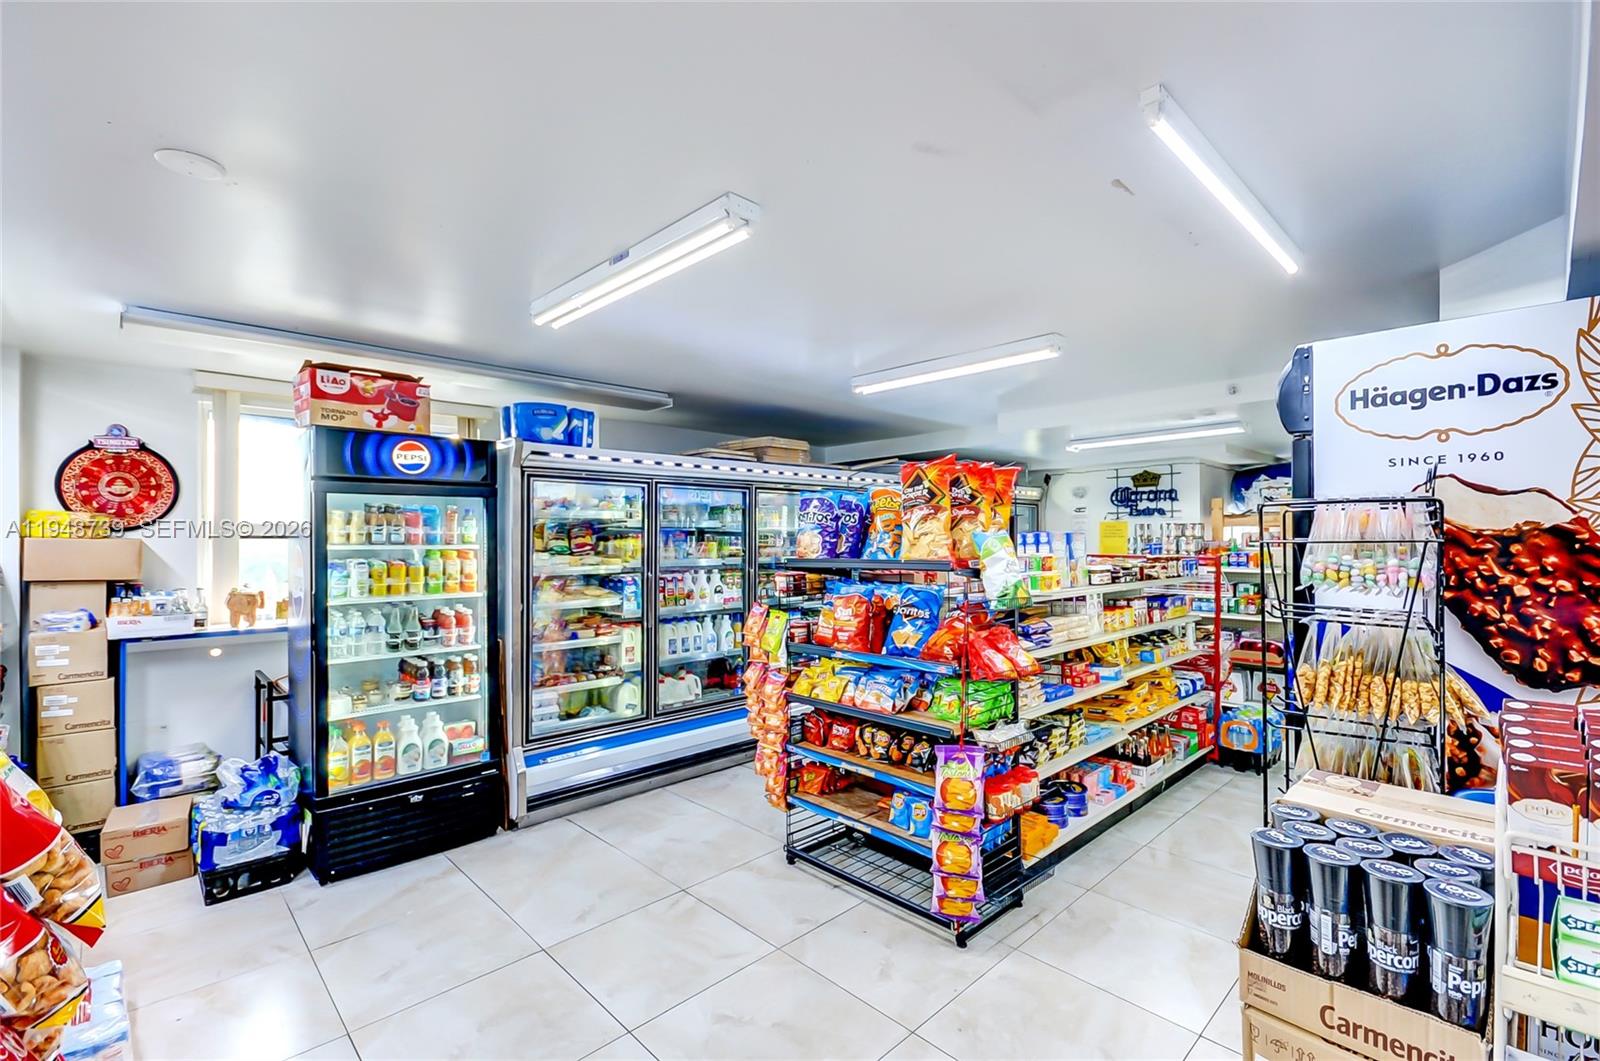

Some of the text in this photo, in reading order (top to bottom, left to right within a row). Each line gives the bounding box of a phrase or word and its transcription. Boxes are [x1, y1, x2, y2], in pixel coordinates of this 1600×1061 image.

[1350, 372, 1559, 411] Häagen-Dazs
[320, 407, 358, 417] TORNADO
[320, 413, 346, 422] MOP
[396, 453, 428, 462] PEPSI
[1388, 450, 1505, 468] SINCE 1960
[1110, 486, 1179, 508] Corona
[58, 671, 104, 681] Carmencita
[65, 720, 111, 731] Carmencita
[66, 770, 112, 782] Carmencita
[66, 818, 106, 832] Carmenc
[1294, 823, 1328, 835] 100
[1355, 807, 1495, 844] Carmencita
[132, 825, 168, 839] IBERIA
[1347, 841, 1384, 851] 100
[1391, 839, 1429, 848] 100
[1374, 862, 1414, 876] 100
[1428, 861, 1469, 875] 100
[1439, 883, 1481, 900] 100
[1277, 905, 1295, 914] Black
[1376, 940, 1398, 954] Black
